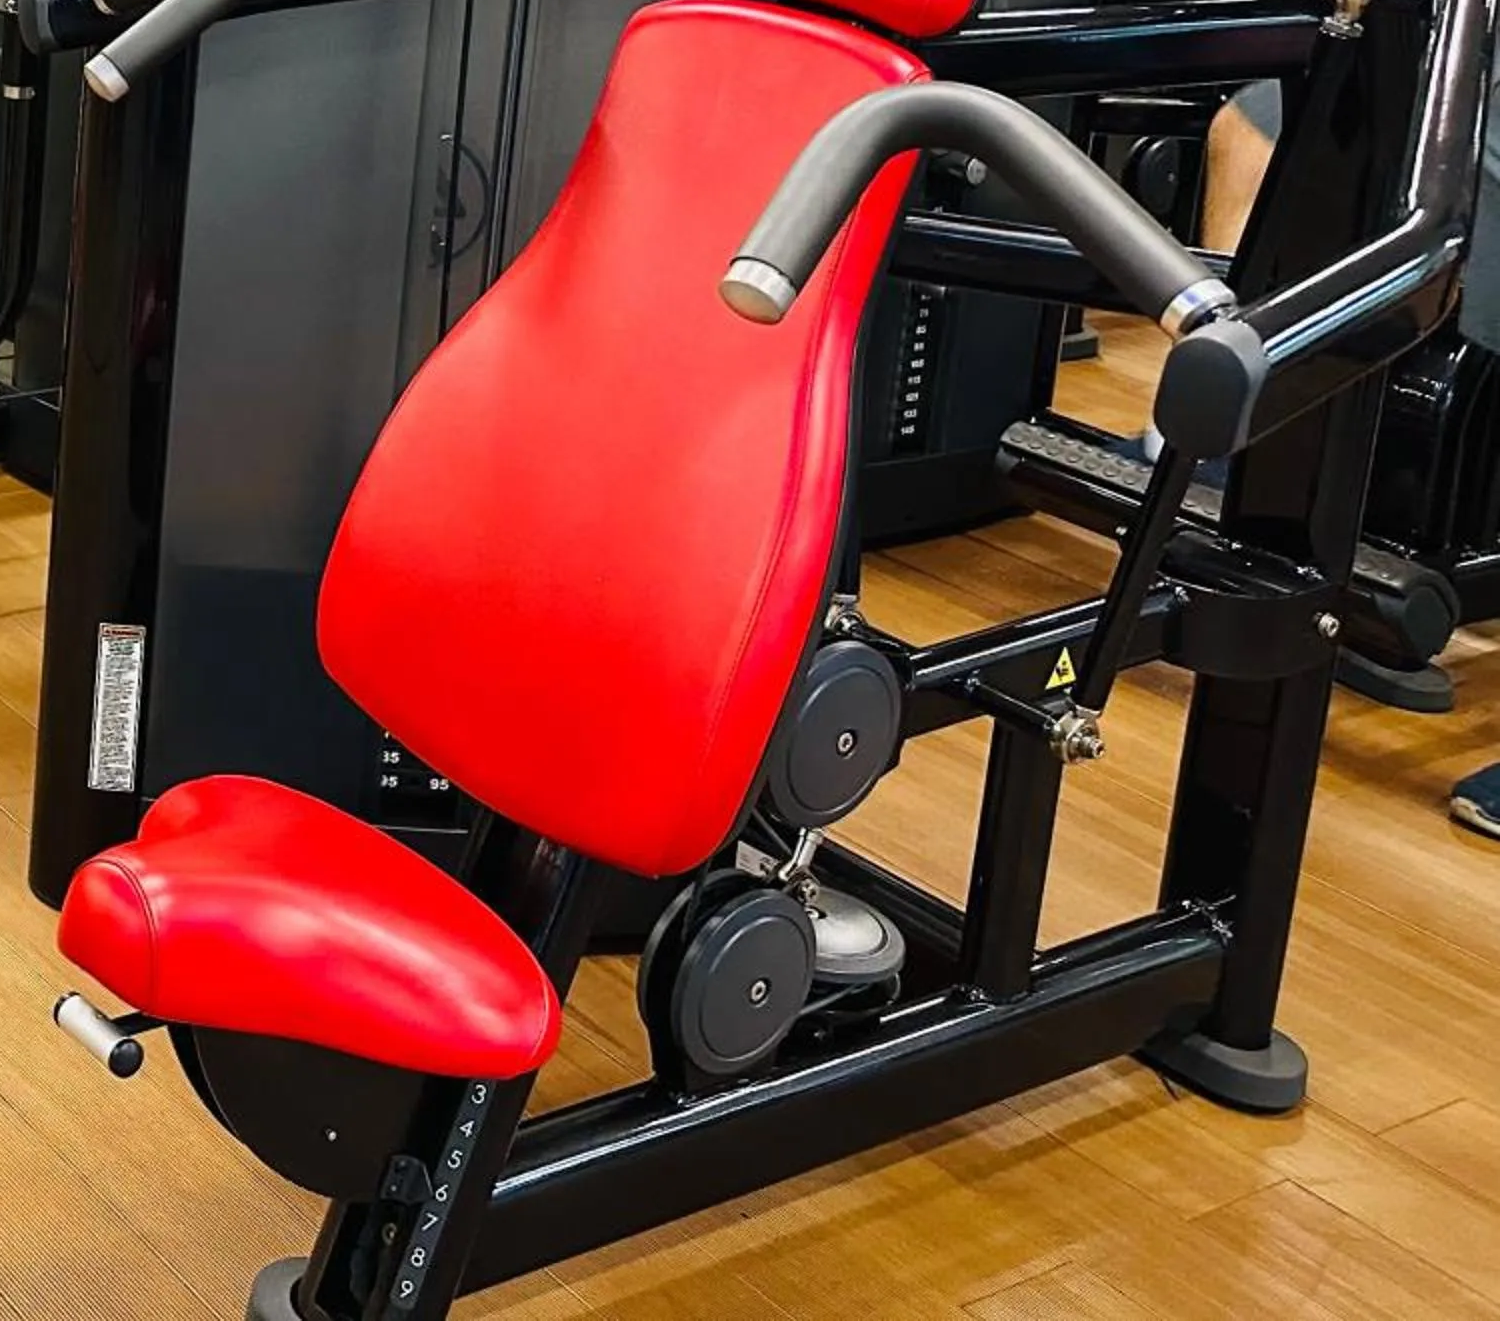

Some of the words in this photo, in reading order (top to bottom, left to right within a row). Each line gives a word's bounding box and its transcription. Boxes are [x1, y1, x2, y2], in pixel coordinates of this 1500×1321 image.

[430, 778, 449, 791] 95
[471, 1084, 487, 1104] 3
[460, 1120, 475, 1137] 4
[447, 1150, 463, 1169] 5
[435, 1184, 449, 1202] 6
[422, 1213, 438, 1231] 7
[410, 1248, 425, 1267] 8
[400, 1280, 414, 1298] 9
